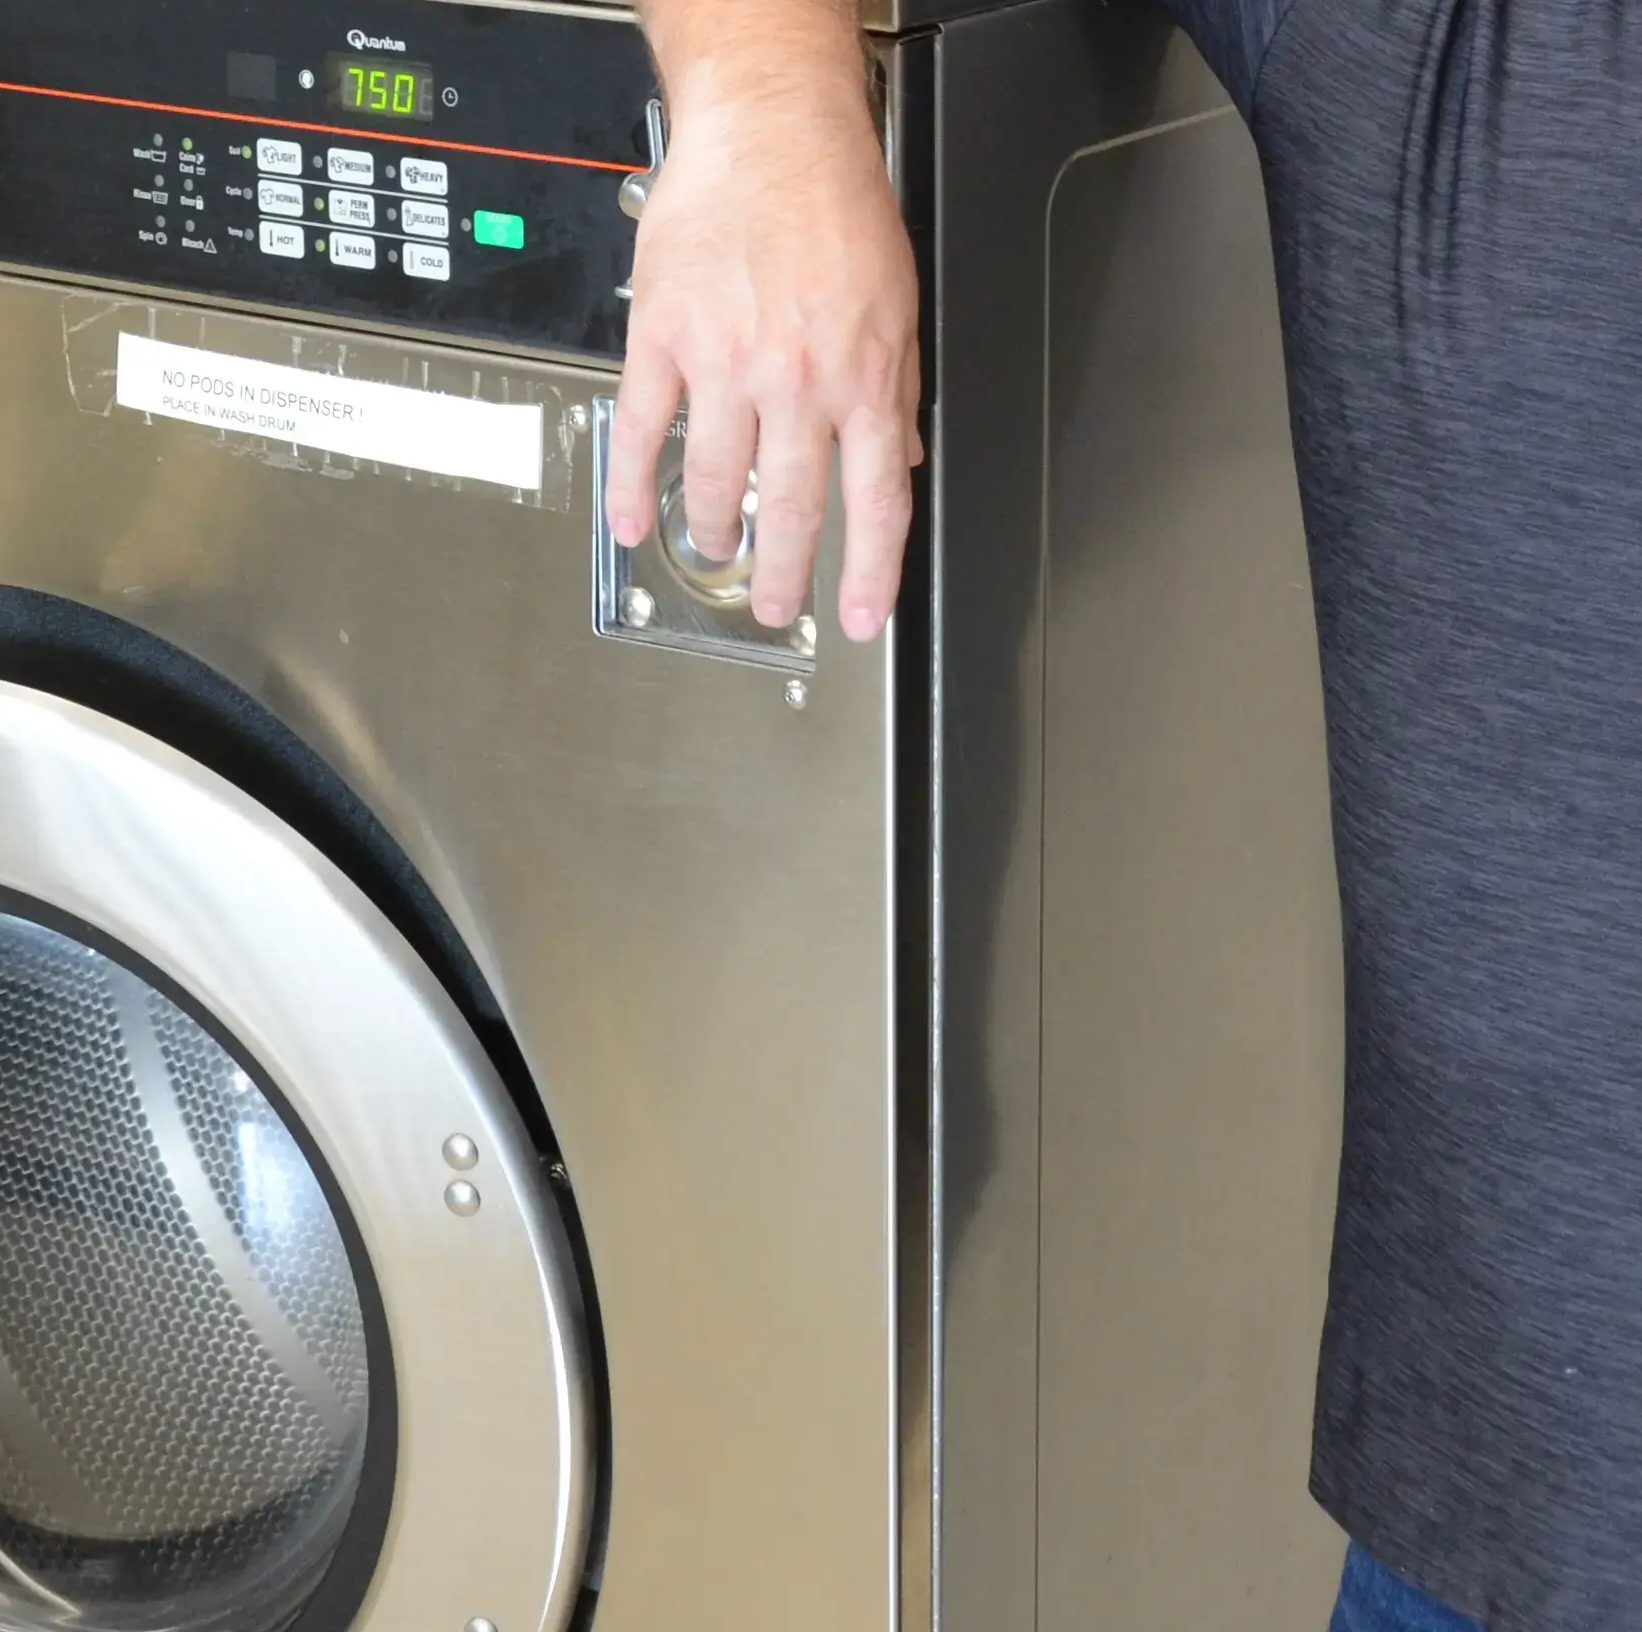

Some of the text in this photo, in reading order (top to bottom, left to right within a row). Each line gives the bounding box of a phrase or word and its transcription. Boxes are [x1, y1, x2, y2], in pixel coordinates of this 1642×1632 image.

[347, 29, 406, 52] Quantum
[348, 68, 415, 113] 750
[276, 152, 296, 164] LIGHT
[344, 161, 372, 174] MEDIUM
[419, 171, 443, 184] HEAVY
[275, 193, 301, 206] NORMAL
[350, 199, 369, 210] PERM
[349, 210, 370, 223] PRESS
[413, 213, 446, 227] DELICATES
[277, 235, 295, 246] HOT
[344, 244, 372, 258] WARM
[420, 256, 443, 268] COLD
[162, 369, 185, 388] NO
[190, 374, 234, 398] PODS
[240, 384, 255, 402] IN
[260, 388, 355, 421] DISPENSER
[163, 396, 296, 432] PLACE IN WASH DRUM
